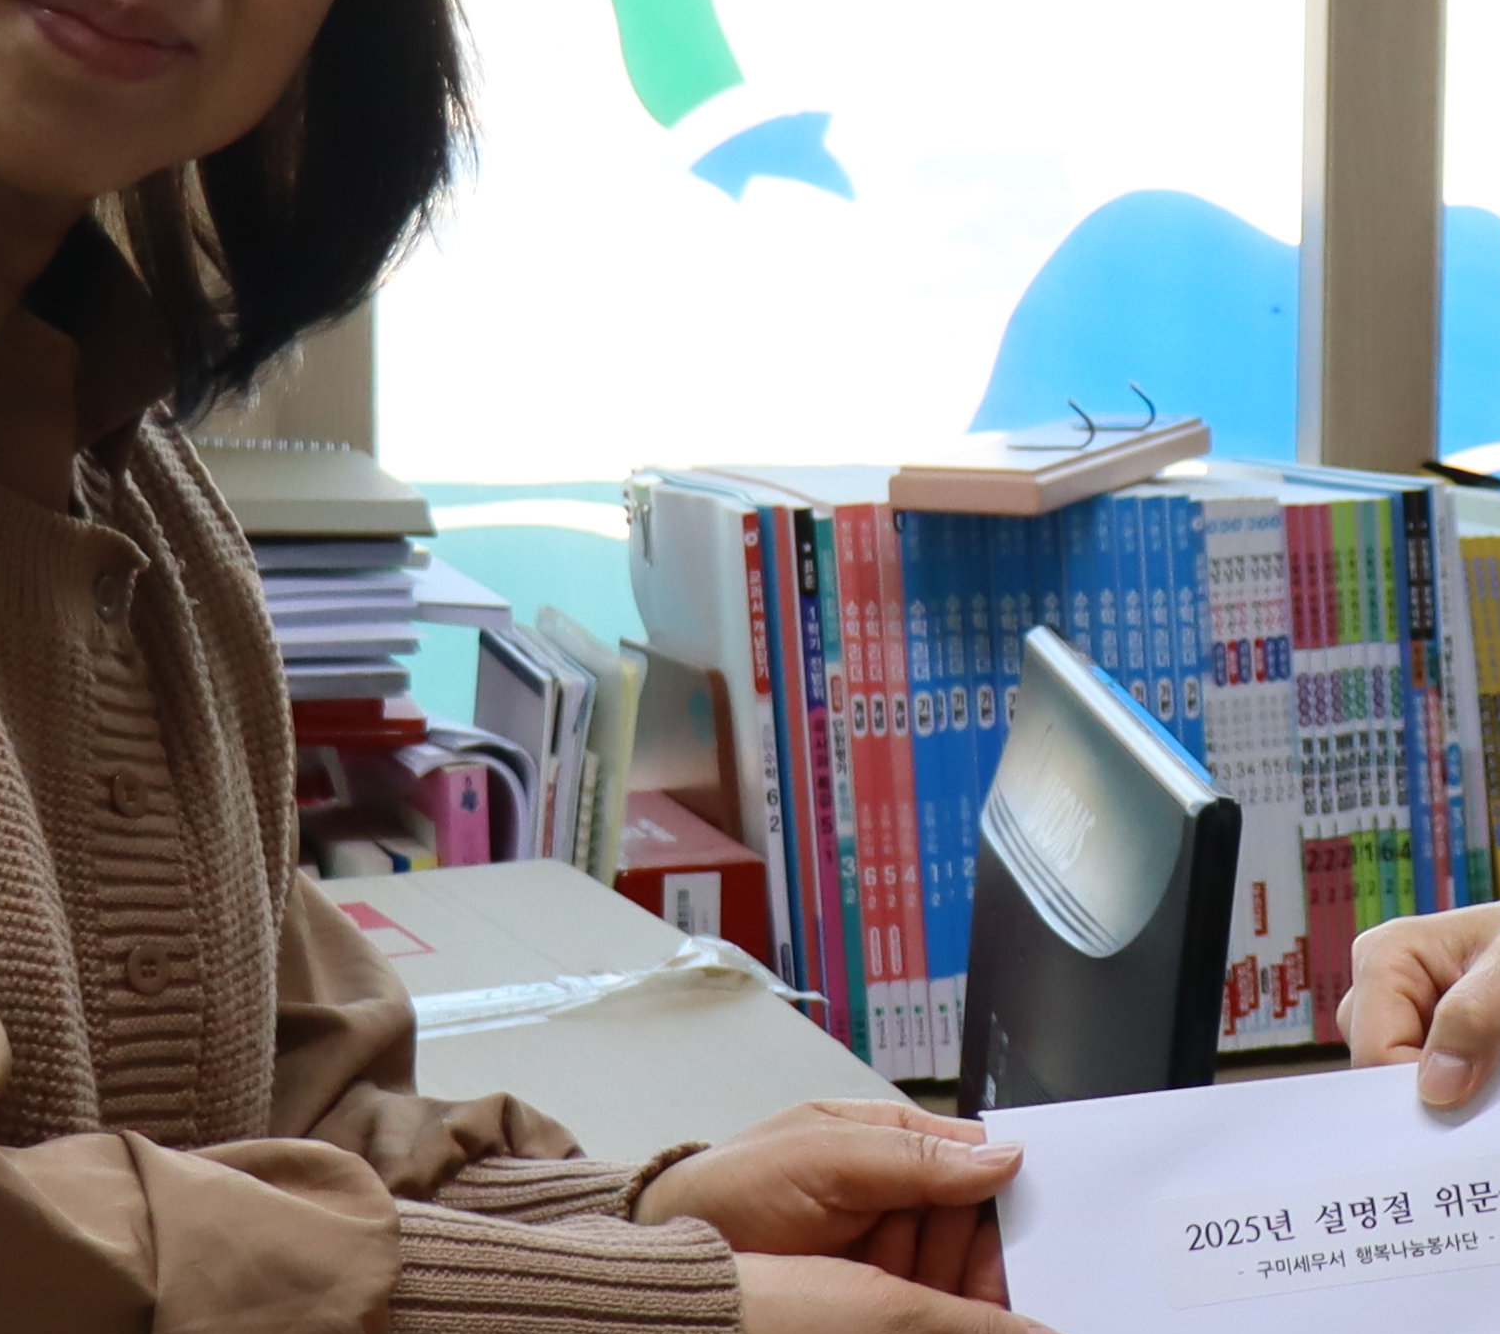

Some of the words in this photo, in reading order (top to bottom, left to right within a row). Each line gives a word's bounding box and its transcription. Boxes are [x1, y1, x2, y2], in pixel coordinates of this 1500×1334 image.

[1185, 1208, 1296, 1251] 2025년
[1315, 1191, 1415, 1235] 설명절
[1256, 1250, 1348, 1279] 구미세무서
[1356, 1231, 1480, 1266] 행복나눔봉사단
